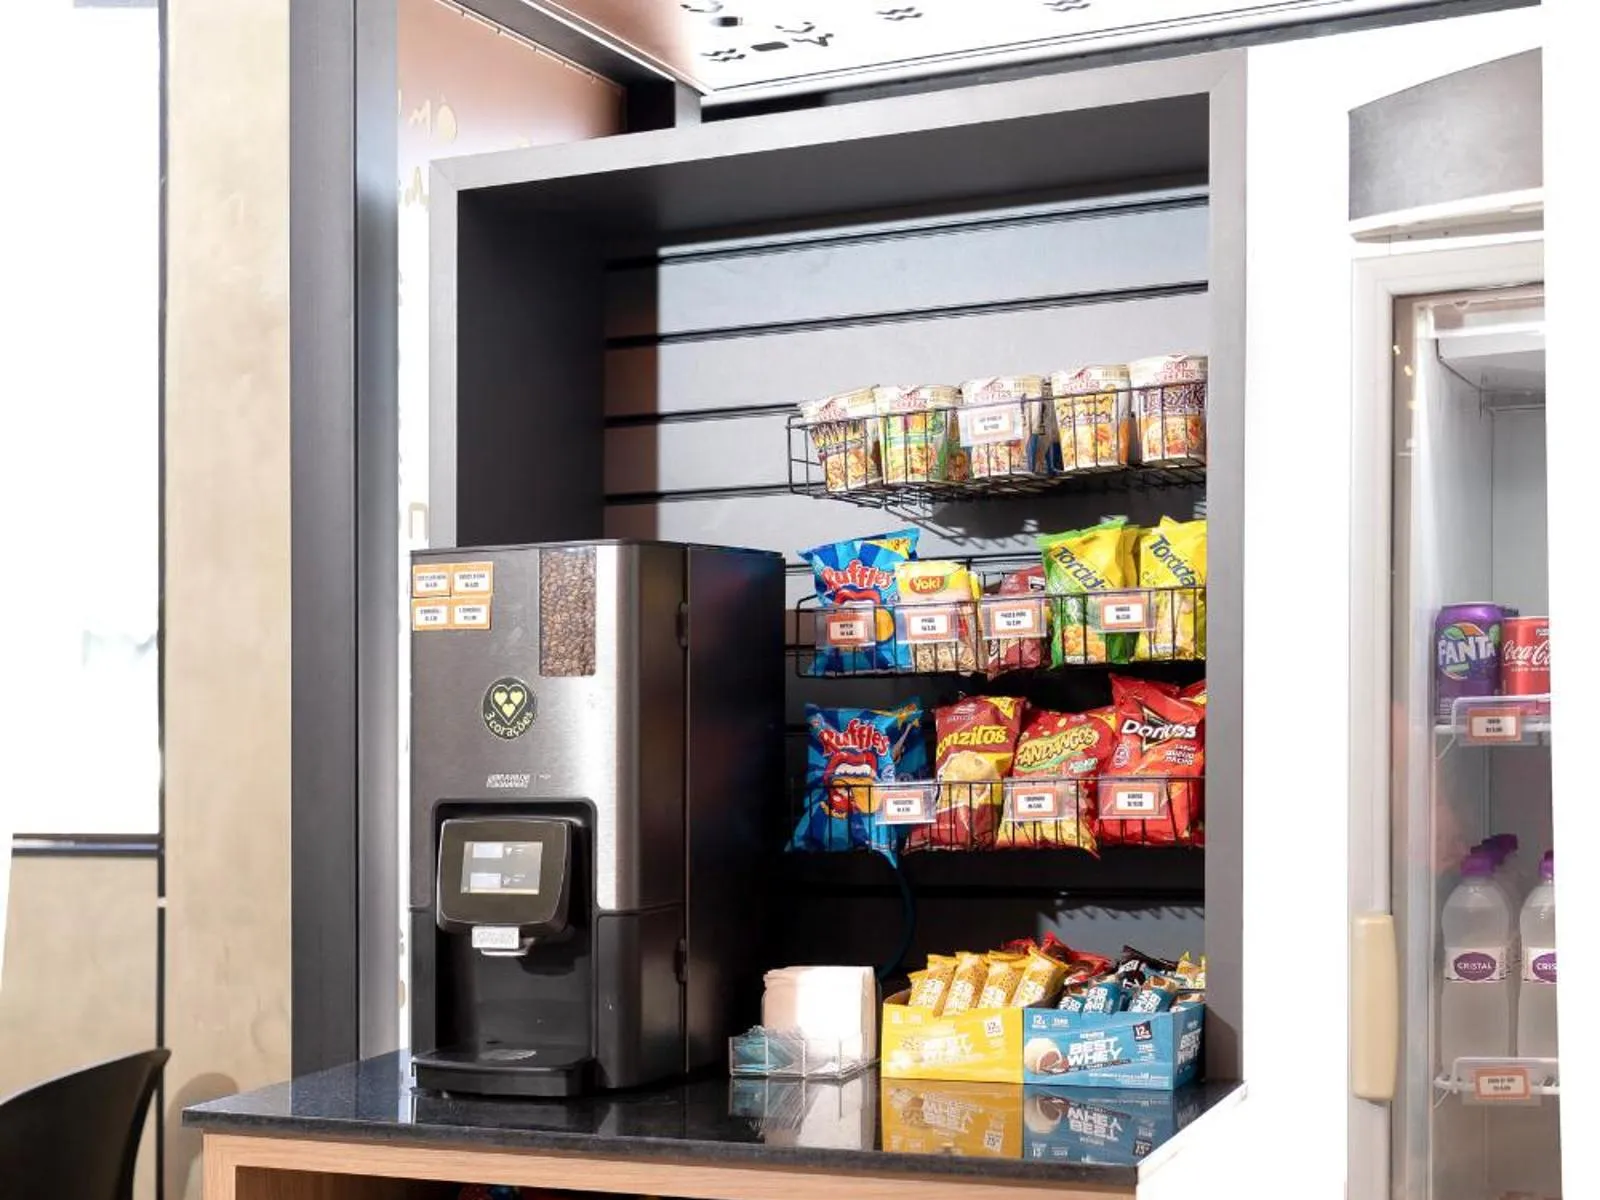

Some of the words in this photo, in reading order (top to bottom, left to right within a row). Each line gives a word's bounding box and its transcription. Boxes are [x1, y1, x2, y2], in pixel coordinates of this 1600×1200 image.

[1438, 636, 1496, 666] FANTA
[819, 718, 892, 757] Ruffles
[1456, 961, 1492, 971] CRISTAL
[1069, 1036, 1120, 1055] BEST
[1066, 1046, 1123, 1067] WHEY
